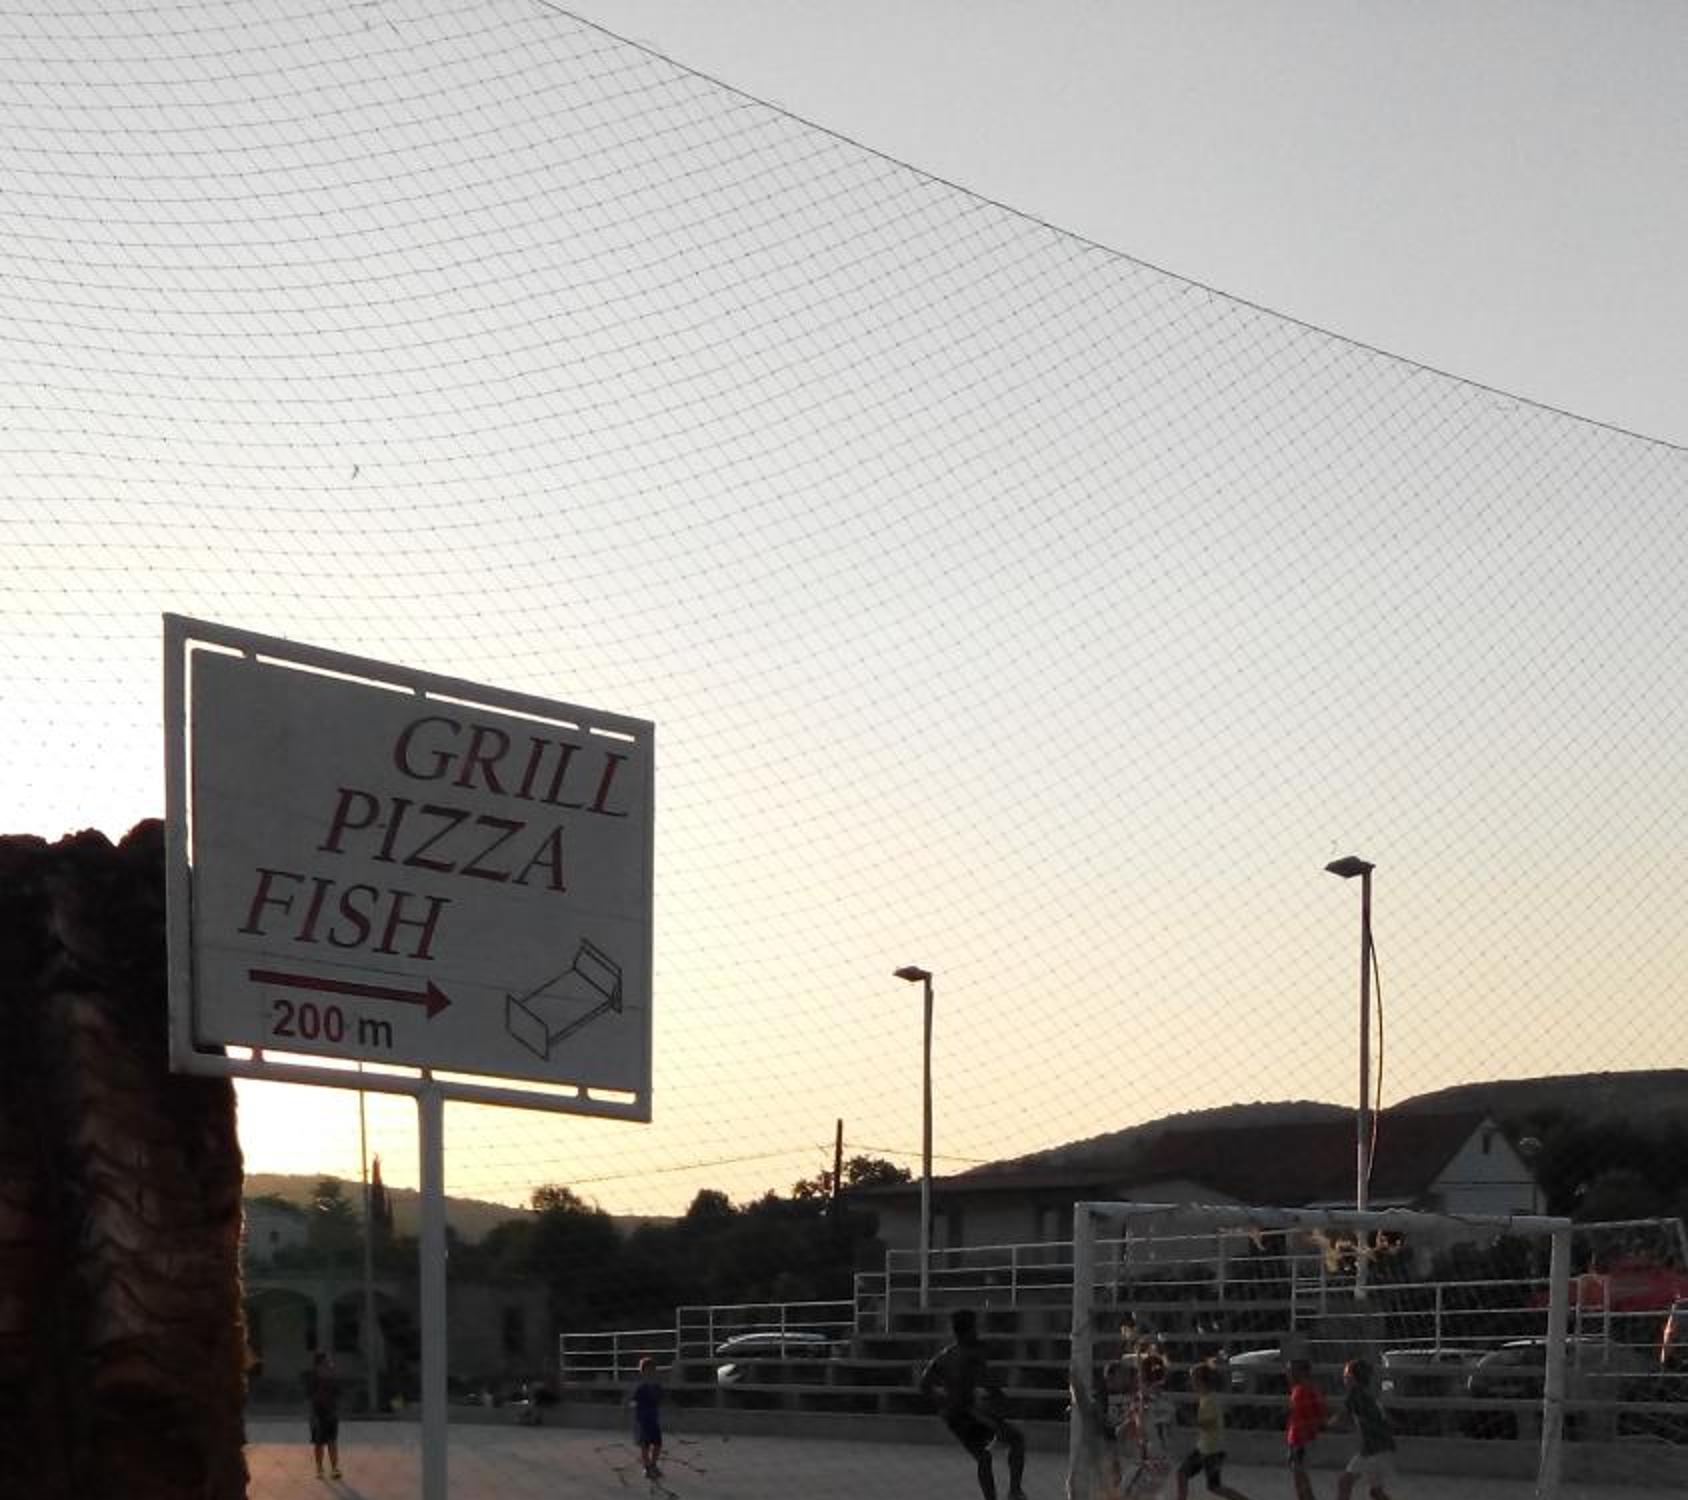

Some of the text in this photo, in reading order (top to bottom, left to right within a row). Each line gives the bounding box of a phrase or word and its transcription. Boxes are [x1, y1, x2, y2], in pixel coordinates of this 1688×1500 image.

[394, 716, 630, 818] GRILL
[317, 787, 568, 894] PIZZA
[237, 867, 453, 961] FISH
[272, 999, 393, 1049] 200 m
